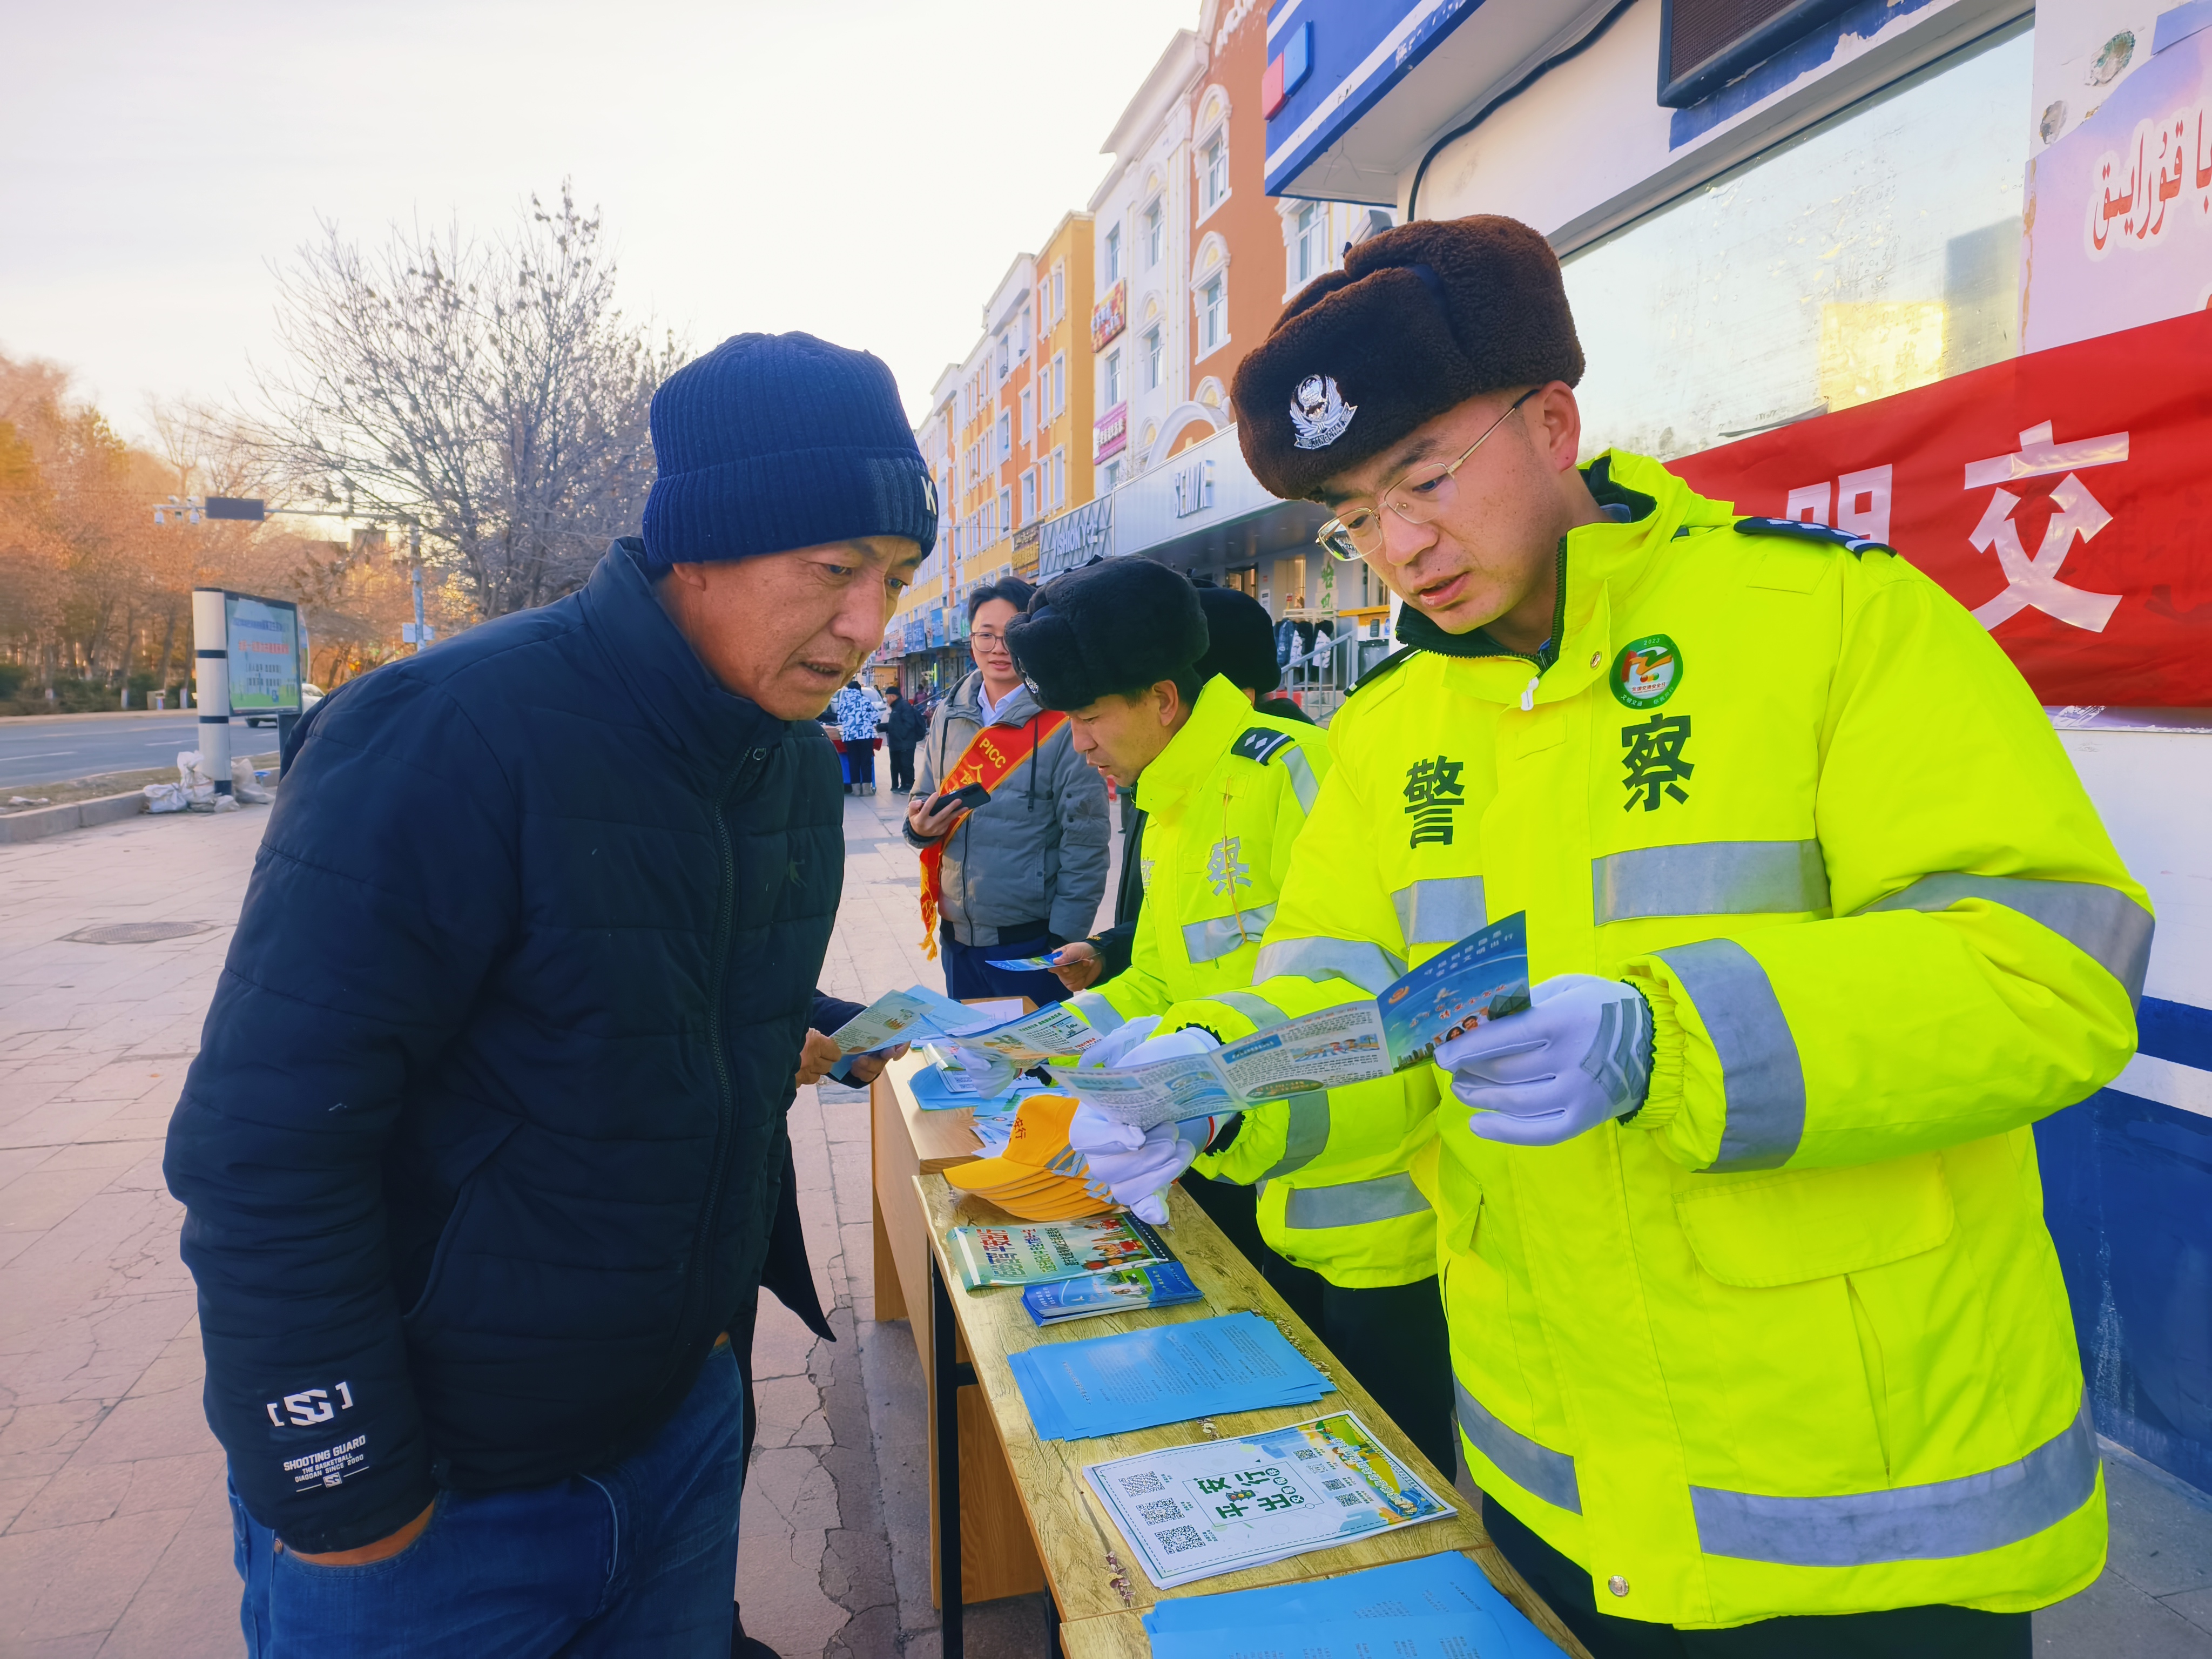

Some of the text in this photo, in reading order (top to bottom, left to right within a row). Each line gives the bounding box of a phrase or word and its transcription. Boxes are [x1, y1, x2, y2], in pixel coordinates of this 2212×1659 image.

[1054, 525, 1081, 557] YISHION
[1621, 694, 1643, 707] 文明交通
[1632, 682, 1666, 692] 全国交通安全日
[980, 737, 1006, 768] PICC
[1404, 713, 1695, 849] 警 察
[976, 1229, 1027, 1278] 拒绝酒驾 平安出行
[1044, 1228, 1080, 1266] 遵守交通规则让生活更美好
[284, 1435, 366, 1471] SHOOTING GUARD
[302, 1453, 353, 1474] THE BASKETBALL
[325, 1462, 345, 1474] SINCE
[347, 1454, 364, 1466] 2000
[1332, 1437, 1403, 1501] 感谢您的关注点赞支持
[1265, 1468, 1304, 1503] 交警相伴
